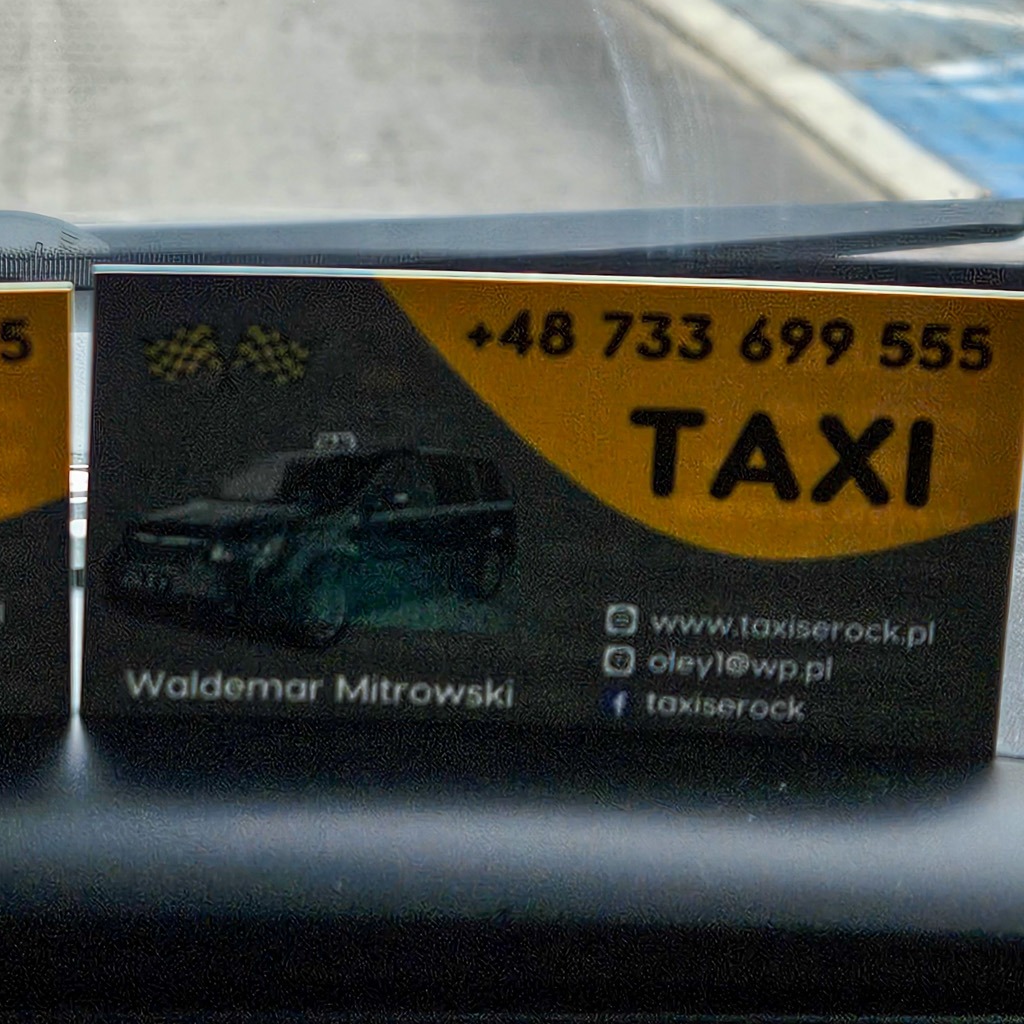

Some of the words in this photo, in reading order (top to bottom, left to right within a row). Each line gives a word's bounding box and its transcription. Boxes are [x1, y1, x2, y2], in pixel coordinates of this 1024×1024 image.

[467, 310, 575, 358] +48
[603, 312, 714, 361] 733
[741, 316, 854, 364] 699
[880, 321, 993, 371] 555
[629, 407, 936, 509] TAXI
[651, 613, 936, 647] www.taxiserock.pl
[126, 670, 323, 702] Waldemar
[336, 676, 515, 709] Mitrowski
[646, 694, 805, 721] taxiserock
